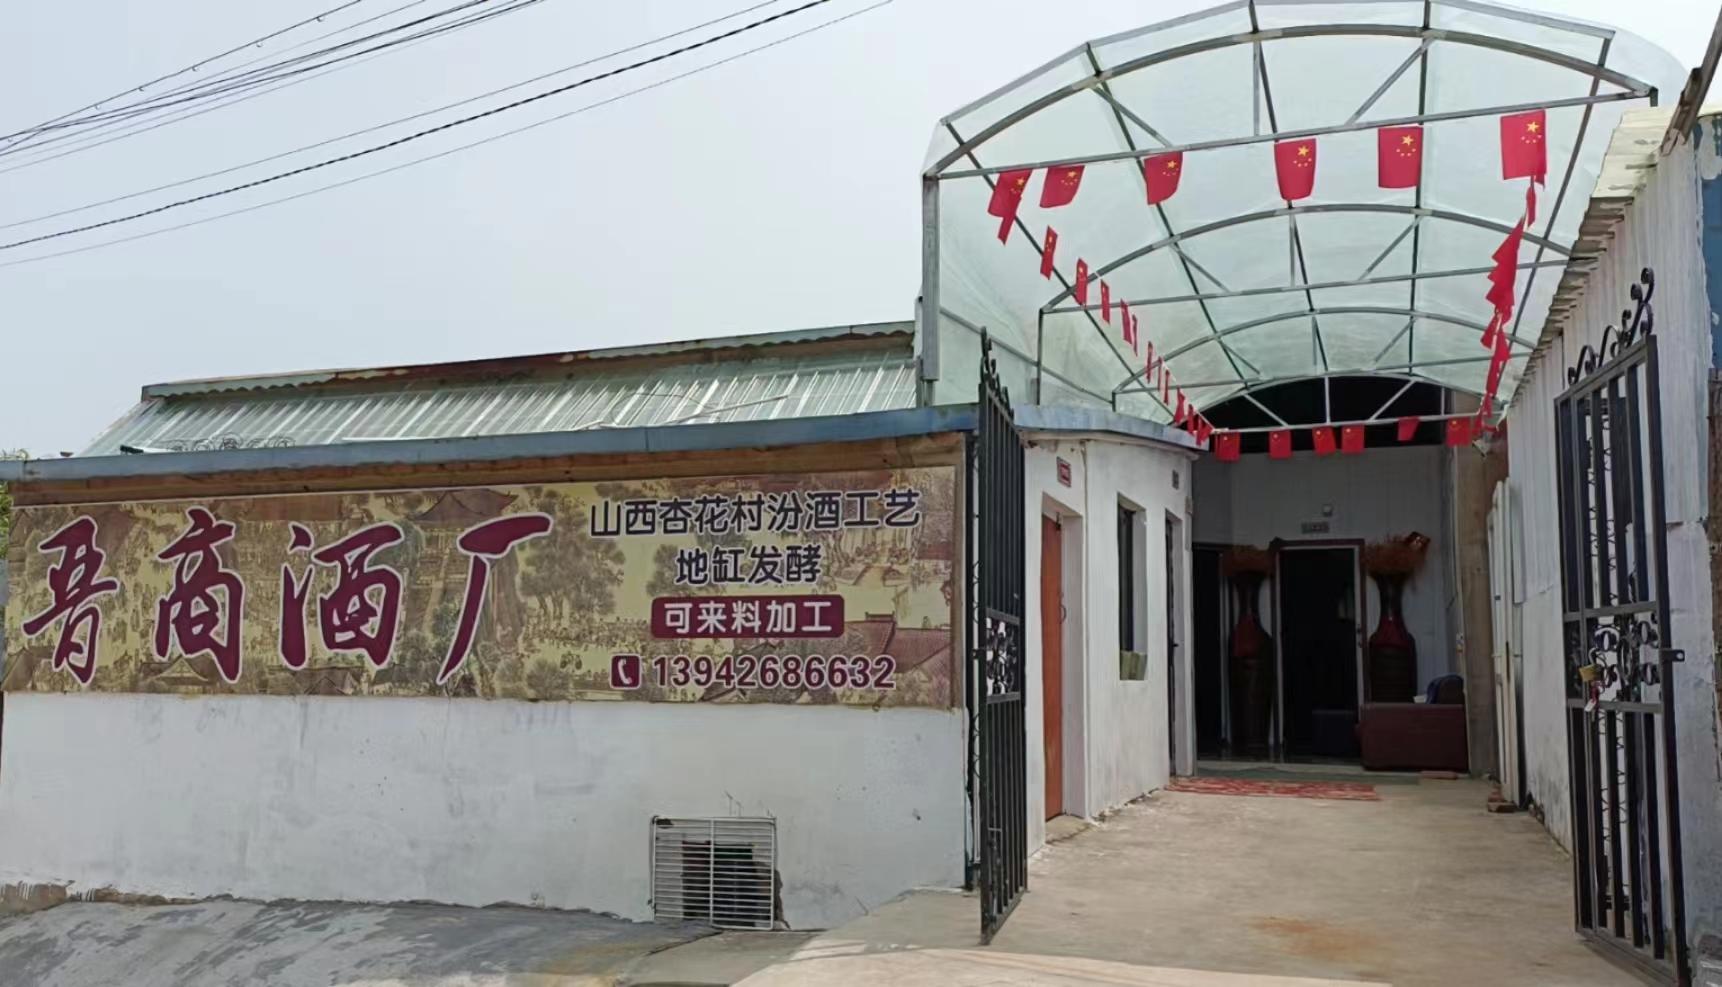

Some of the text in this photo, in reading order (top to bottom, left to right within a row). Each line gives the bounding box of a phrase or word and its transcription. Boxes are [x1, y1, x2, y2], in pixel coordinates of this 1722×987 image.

[590, 488, 921, 536] 山西杏花村汾酒工艺
[676, 545, 822, 585] 地缸发酵
[23, 508, 552, 684] 晋商酒厂
[664, 601, 832, 634] 可来料加工
[654, 656, 895, 688] 13942686632
